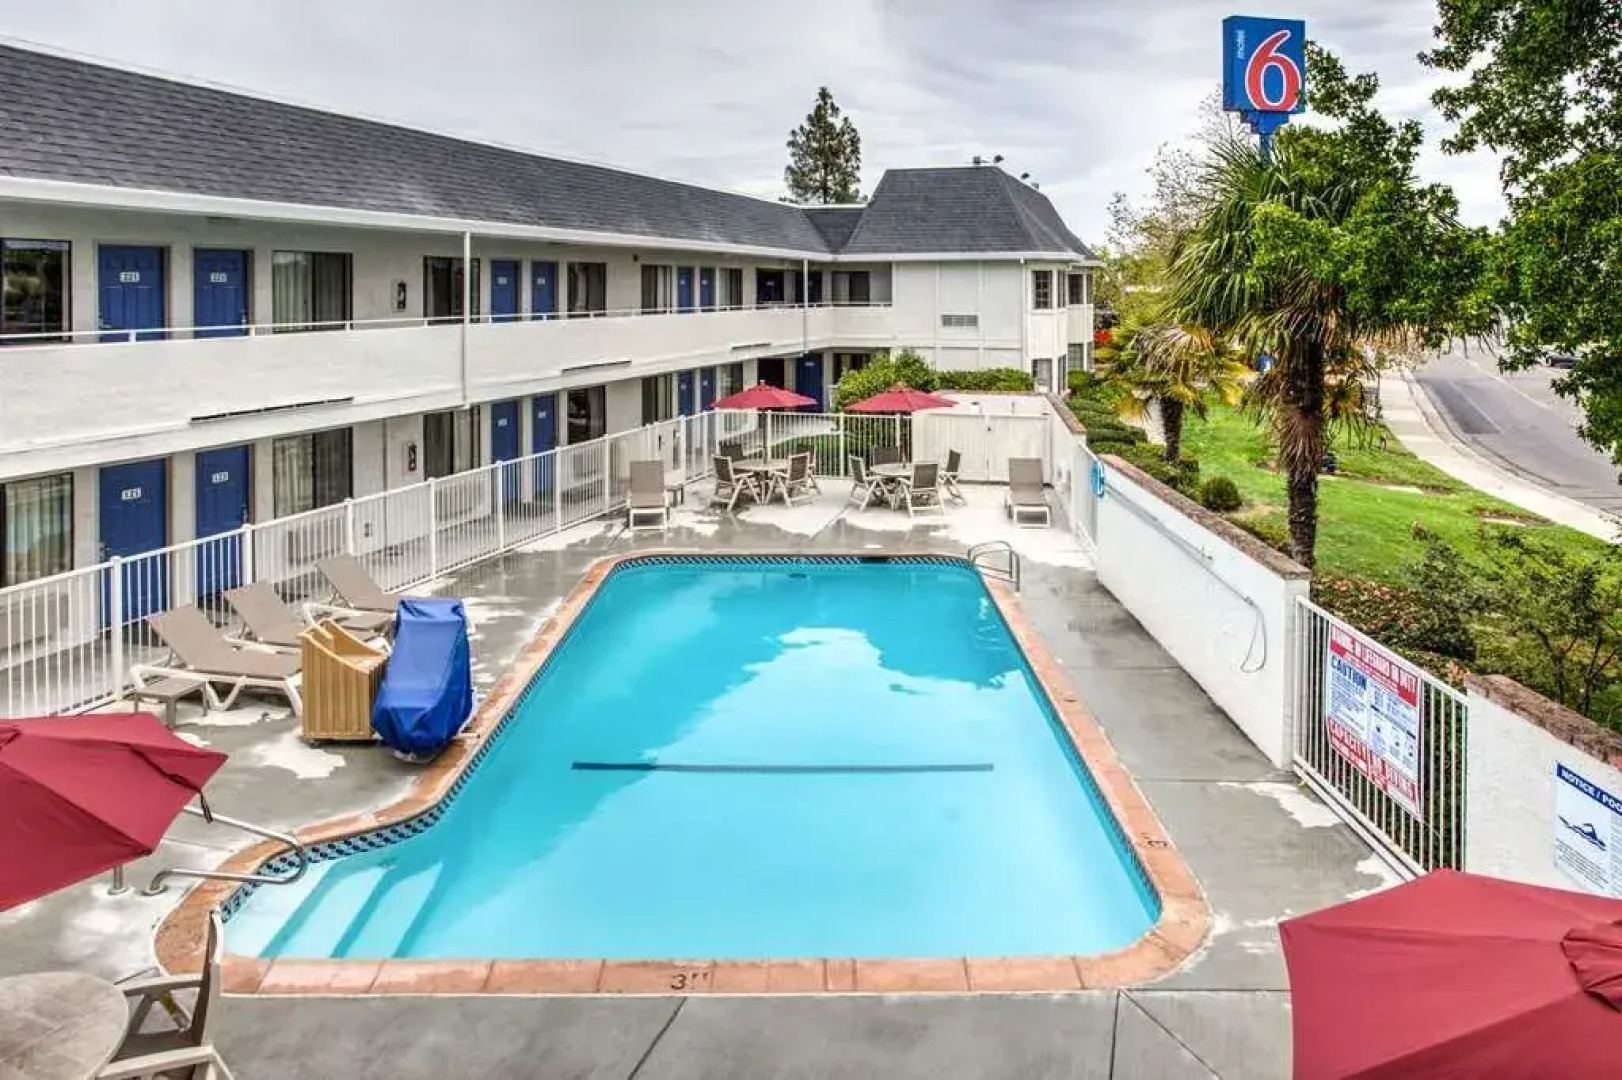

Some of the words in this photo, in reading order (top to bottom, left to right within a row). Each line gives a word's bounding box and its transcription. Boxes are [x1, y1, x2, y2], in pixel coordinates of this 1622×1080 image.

[1245, 29, 1301, 111] 6
[1331, 654, 1367, 689] CAUTION
[1561, 769, 1595, 797] NOTICE
